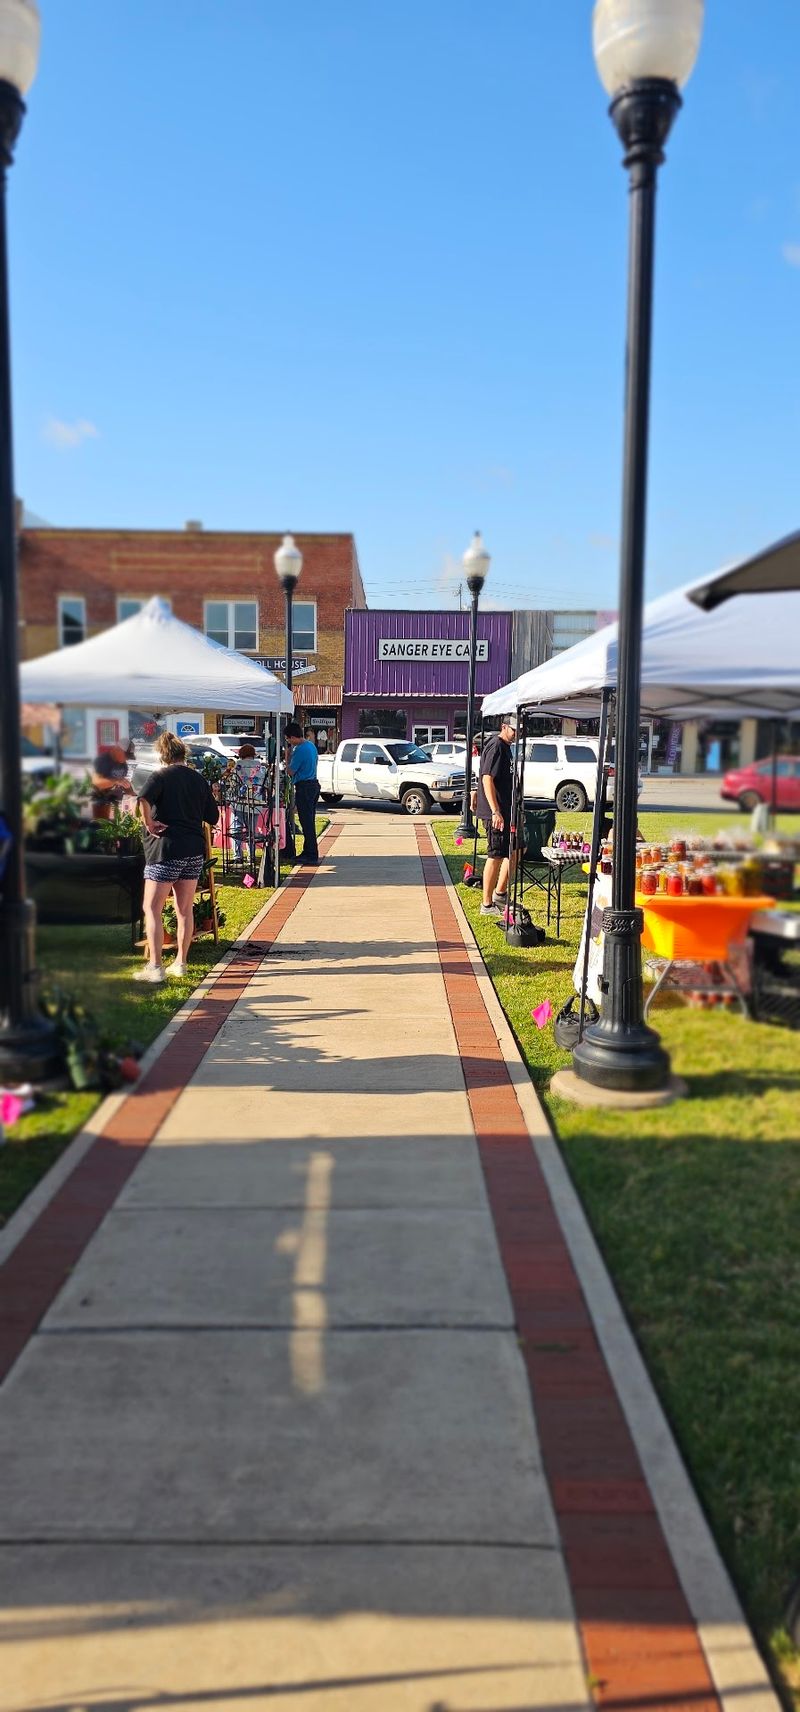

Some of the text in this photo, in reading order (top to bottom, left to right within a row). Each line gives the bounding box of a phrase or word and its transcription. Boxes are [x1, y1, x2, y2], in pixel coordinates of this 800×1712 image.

[382, 643, 429, 657] SANGER
[431, 644, 452, 657] EYE
[255, 660, 272, 669] OLL
[667, 727, 681, 765] FLOWERS
